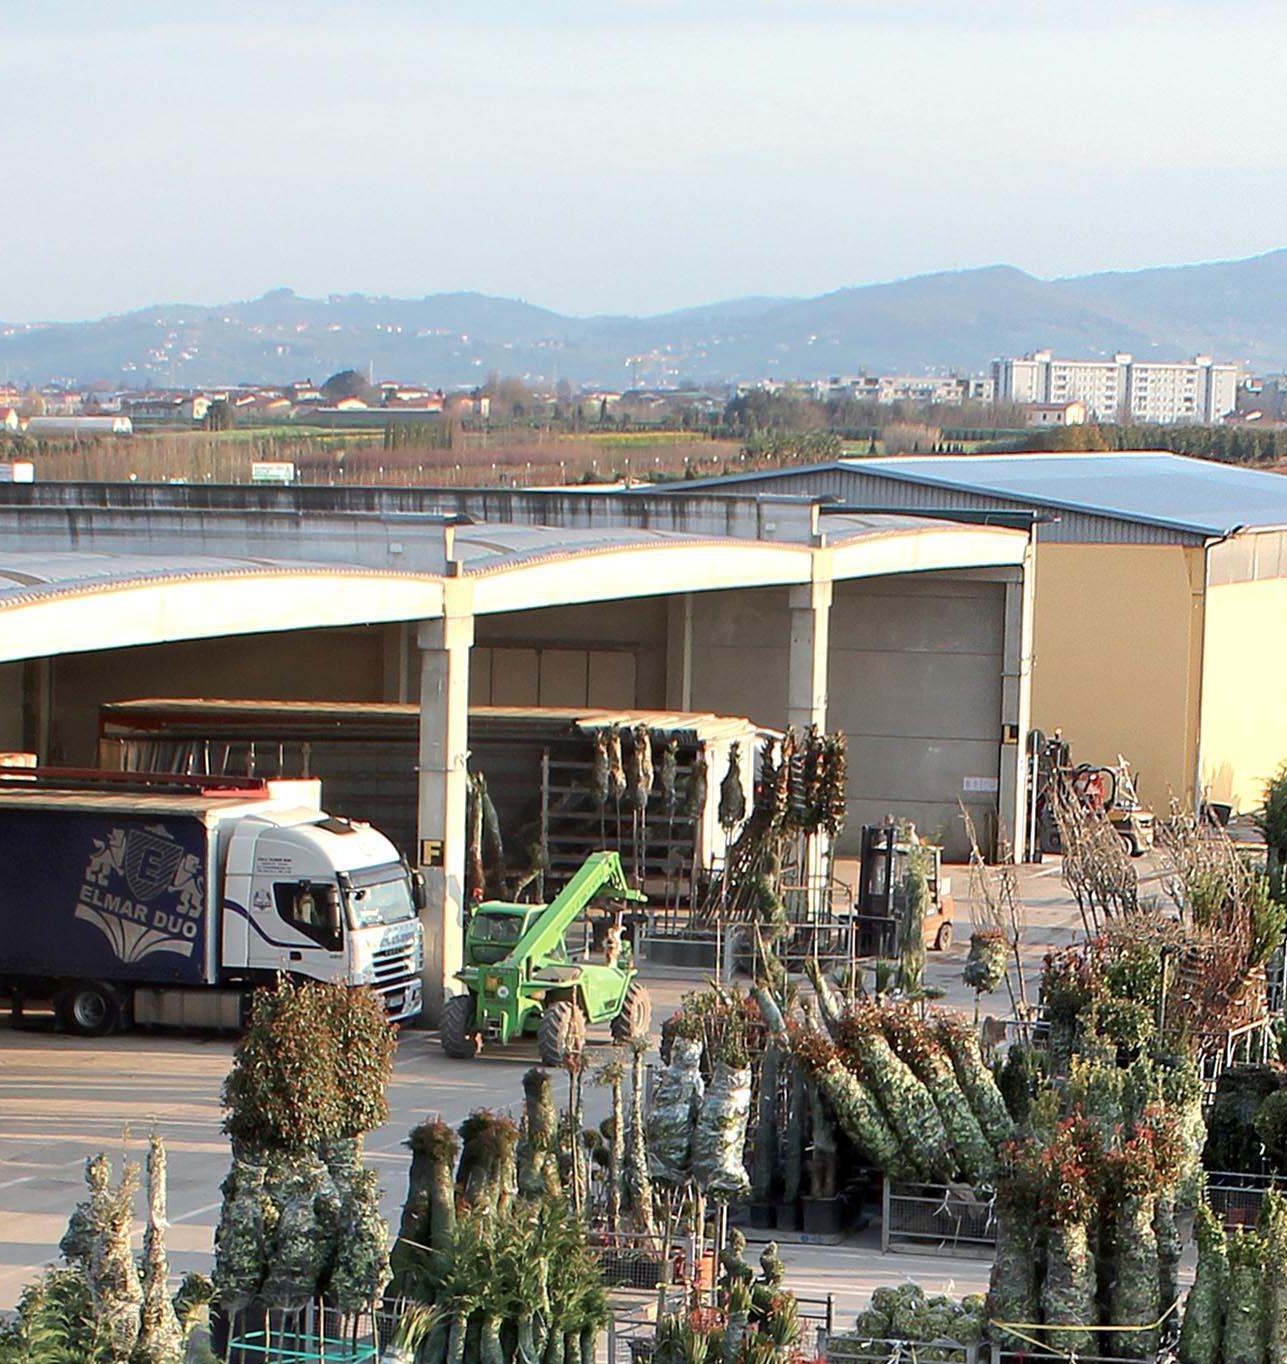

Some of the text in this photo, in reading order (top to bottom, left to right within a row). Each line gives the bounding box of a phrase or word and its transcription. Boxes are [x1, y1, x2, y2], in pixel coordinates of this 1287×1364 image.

[1004, 725, 1017, 743] L
[423, 841, 442, 865] F
[78, 884, 198, 938] ELMAR DUO
